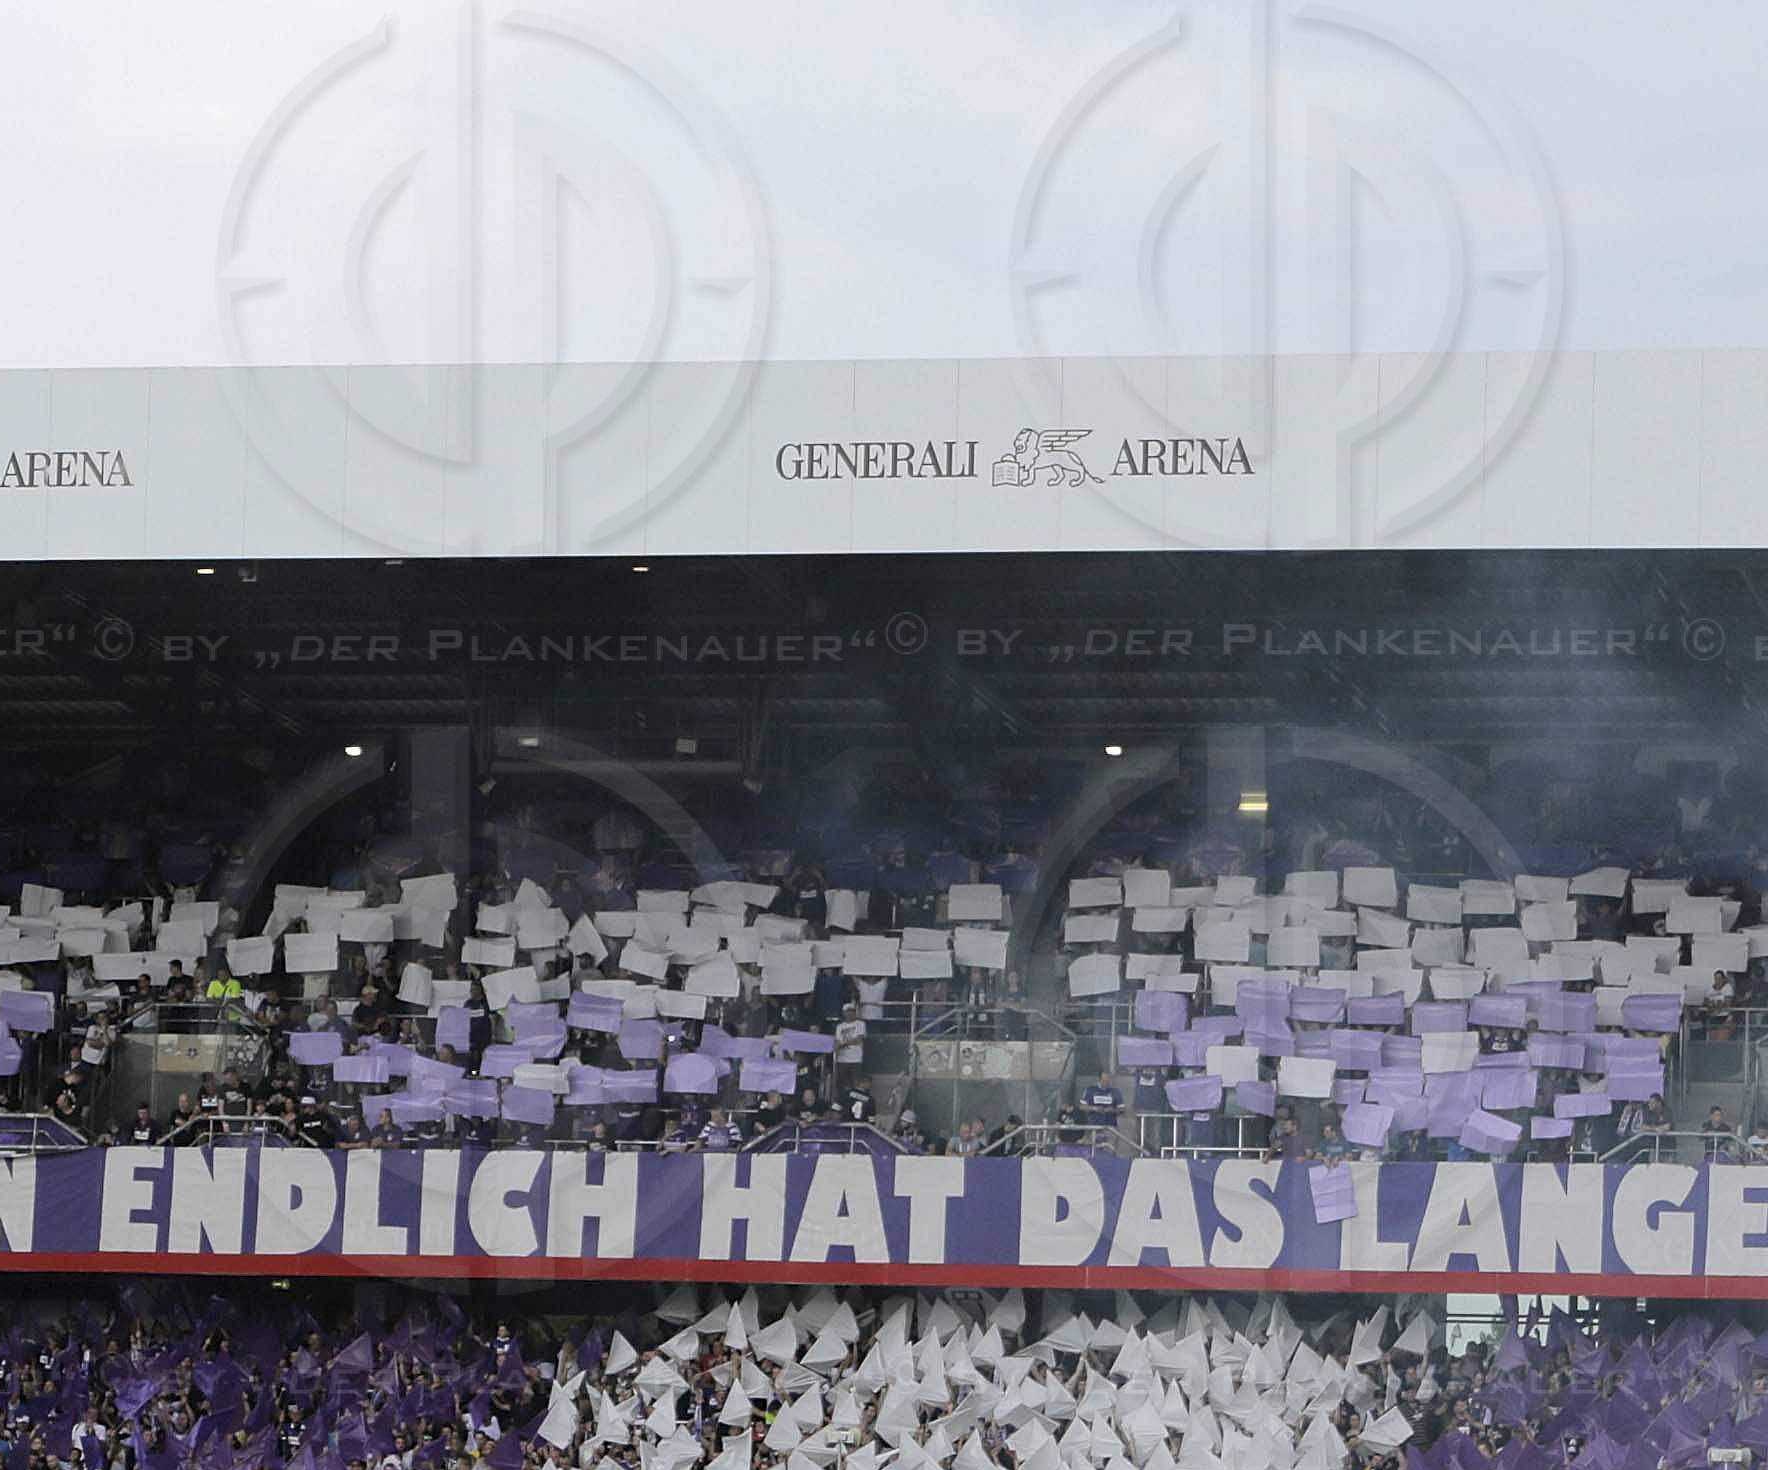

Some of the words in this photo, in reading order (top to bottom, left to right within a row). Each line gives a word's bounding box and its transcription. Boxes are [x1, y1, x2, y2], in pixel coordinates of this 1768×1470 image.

[775, 440, 980, 481] GENERALI
[1109, 437, 1256, 477] ARENA
[98, 1146, 638, 1259] ENDLICH
[697, 1152, 965, 1264] HAT
[1018, 1157, 1286, 1269] DAS
